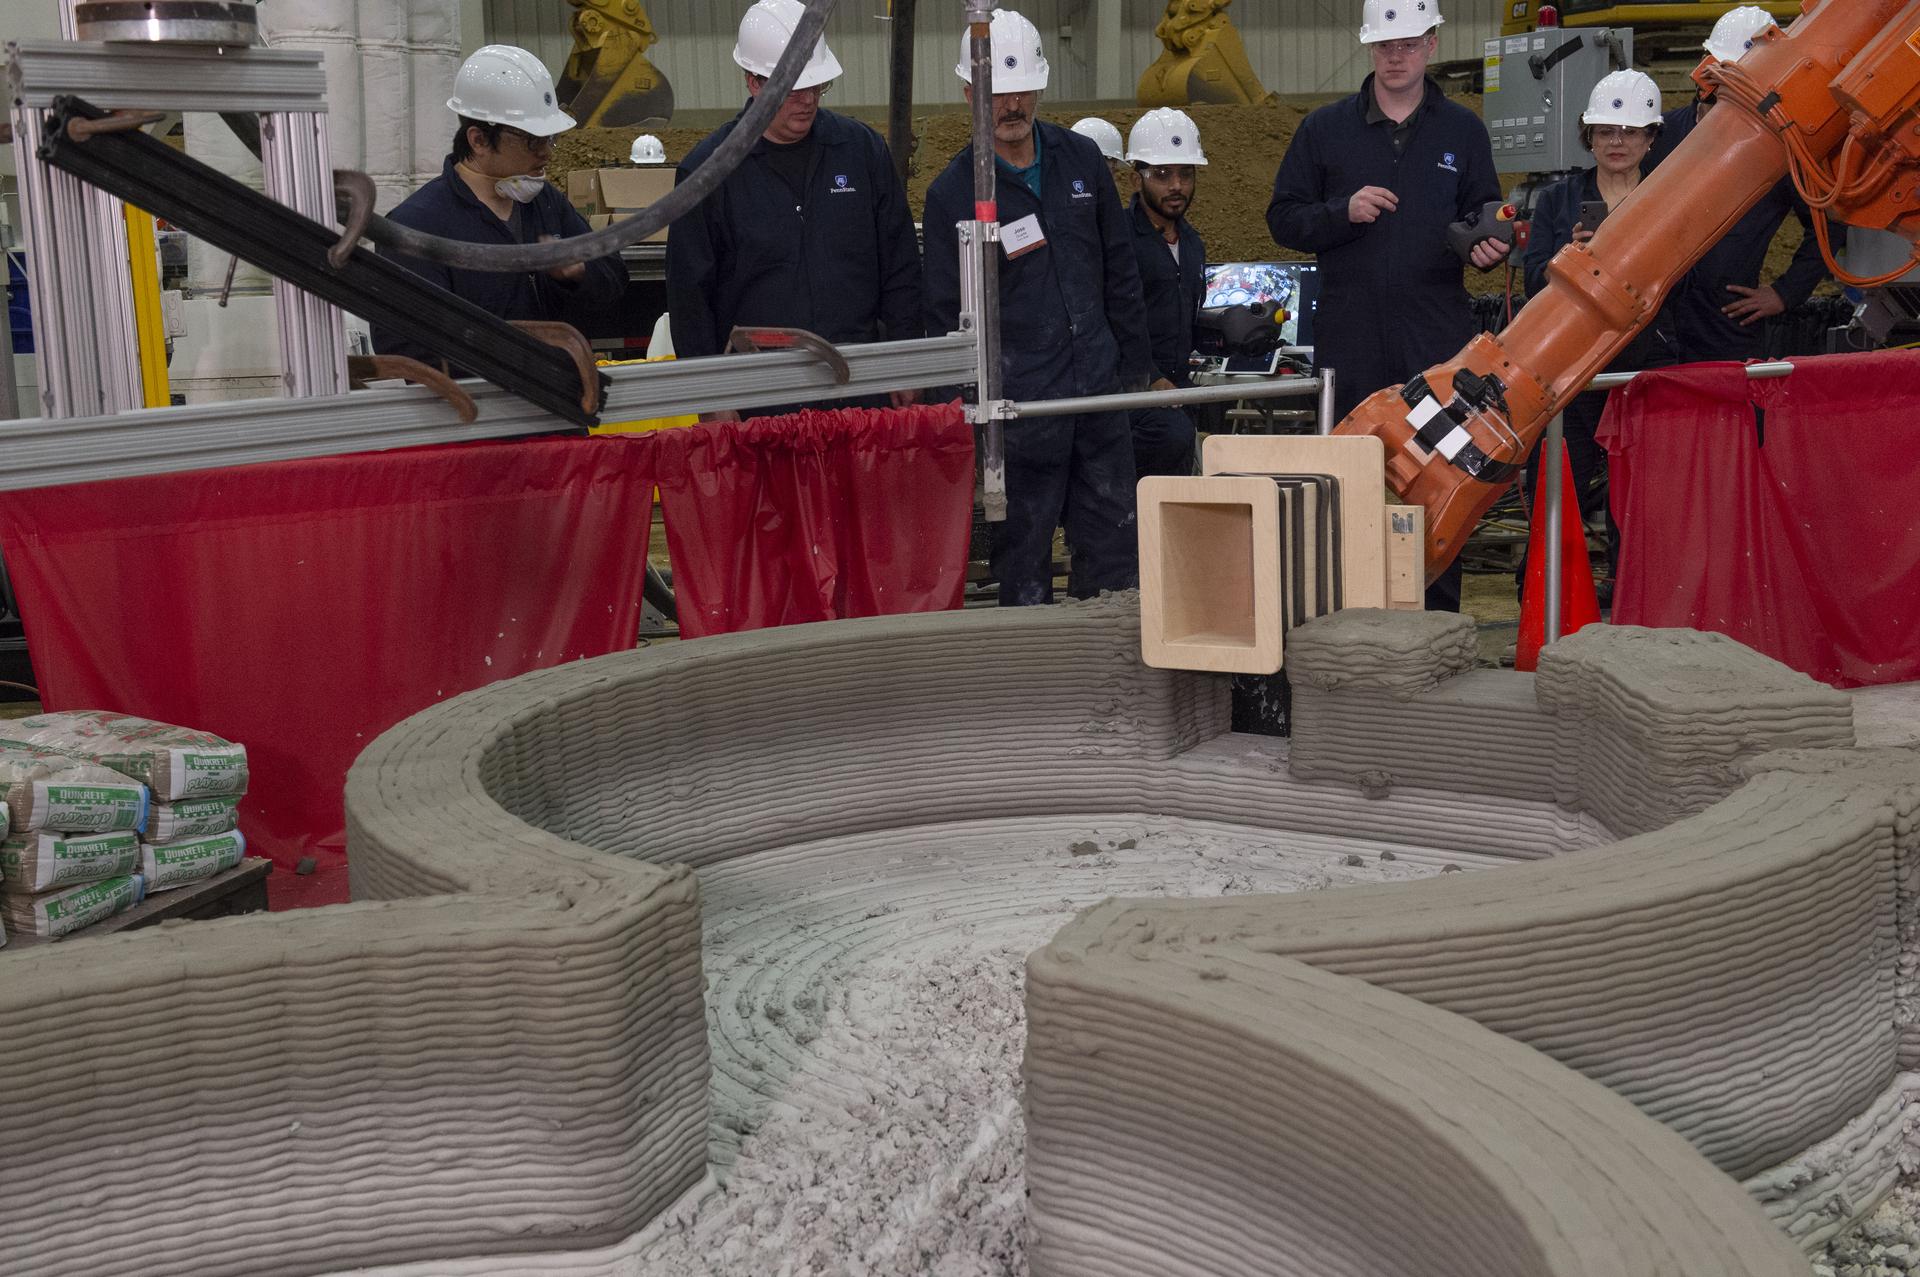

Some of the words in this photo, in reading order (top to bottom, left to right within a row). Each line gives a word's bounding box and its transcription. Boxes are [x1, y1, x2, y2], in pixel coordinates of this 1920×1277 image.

[1513, 3, 1527, 17] CAT
[193, 756, 228, 767] QUIKRETE
[60, 789, 108, 800] QUIKRETE
[182, 802, 220, 814] QUIKRETE
[66, 842, 109, 855] QUIKRETE
[164, 845, 207, 859] QUIKRETE
